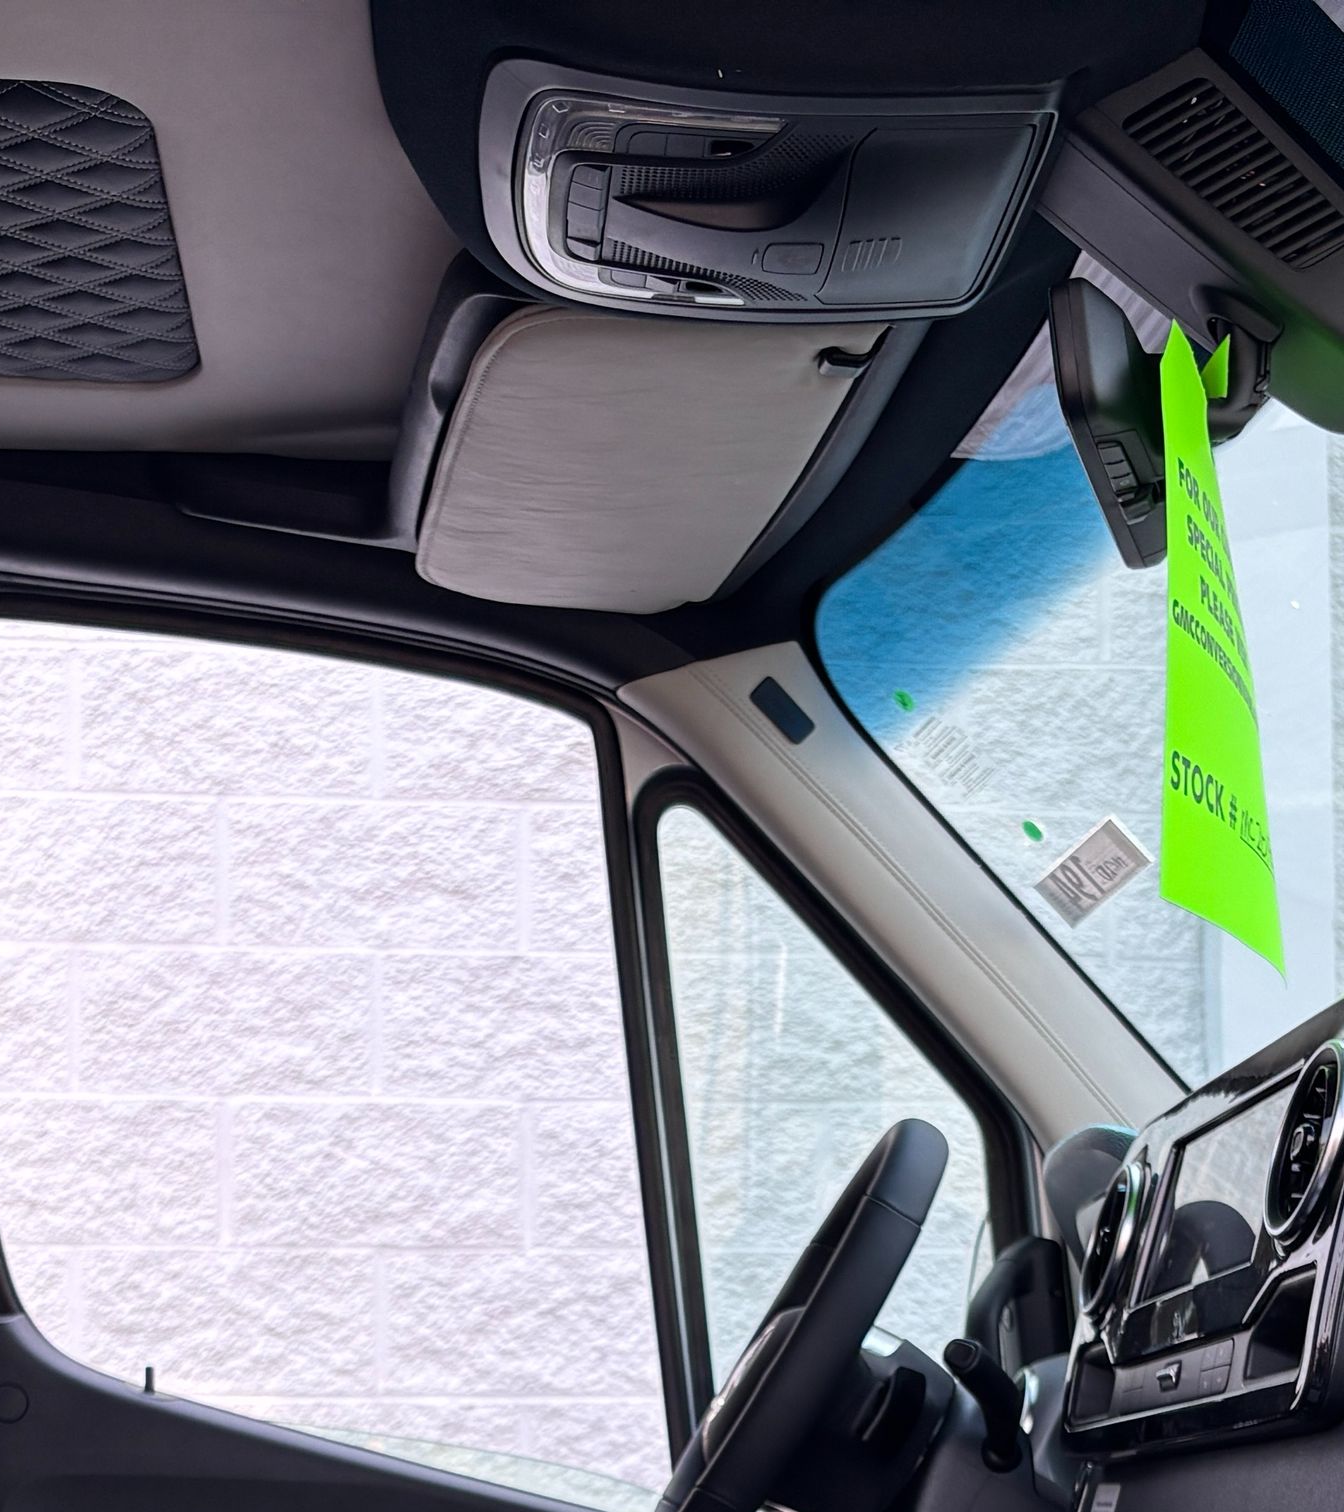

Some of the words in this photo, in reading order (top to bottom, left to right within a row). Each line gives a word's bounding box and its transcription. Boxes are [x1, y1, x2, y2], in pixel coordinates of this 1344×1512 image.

[1178, 457, 1200, 510] FOR
[1186, 514, 1227, 598] SPECIAL
[1199, 575, 1236, 648] PLEASE
[1170, 750, 1226, 822] STOCK
[1229, 794, 1238, 830] #
